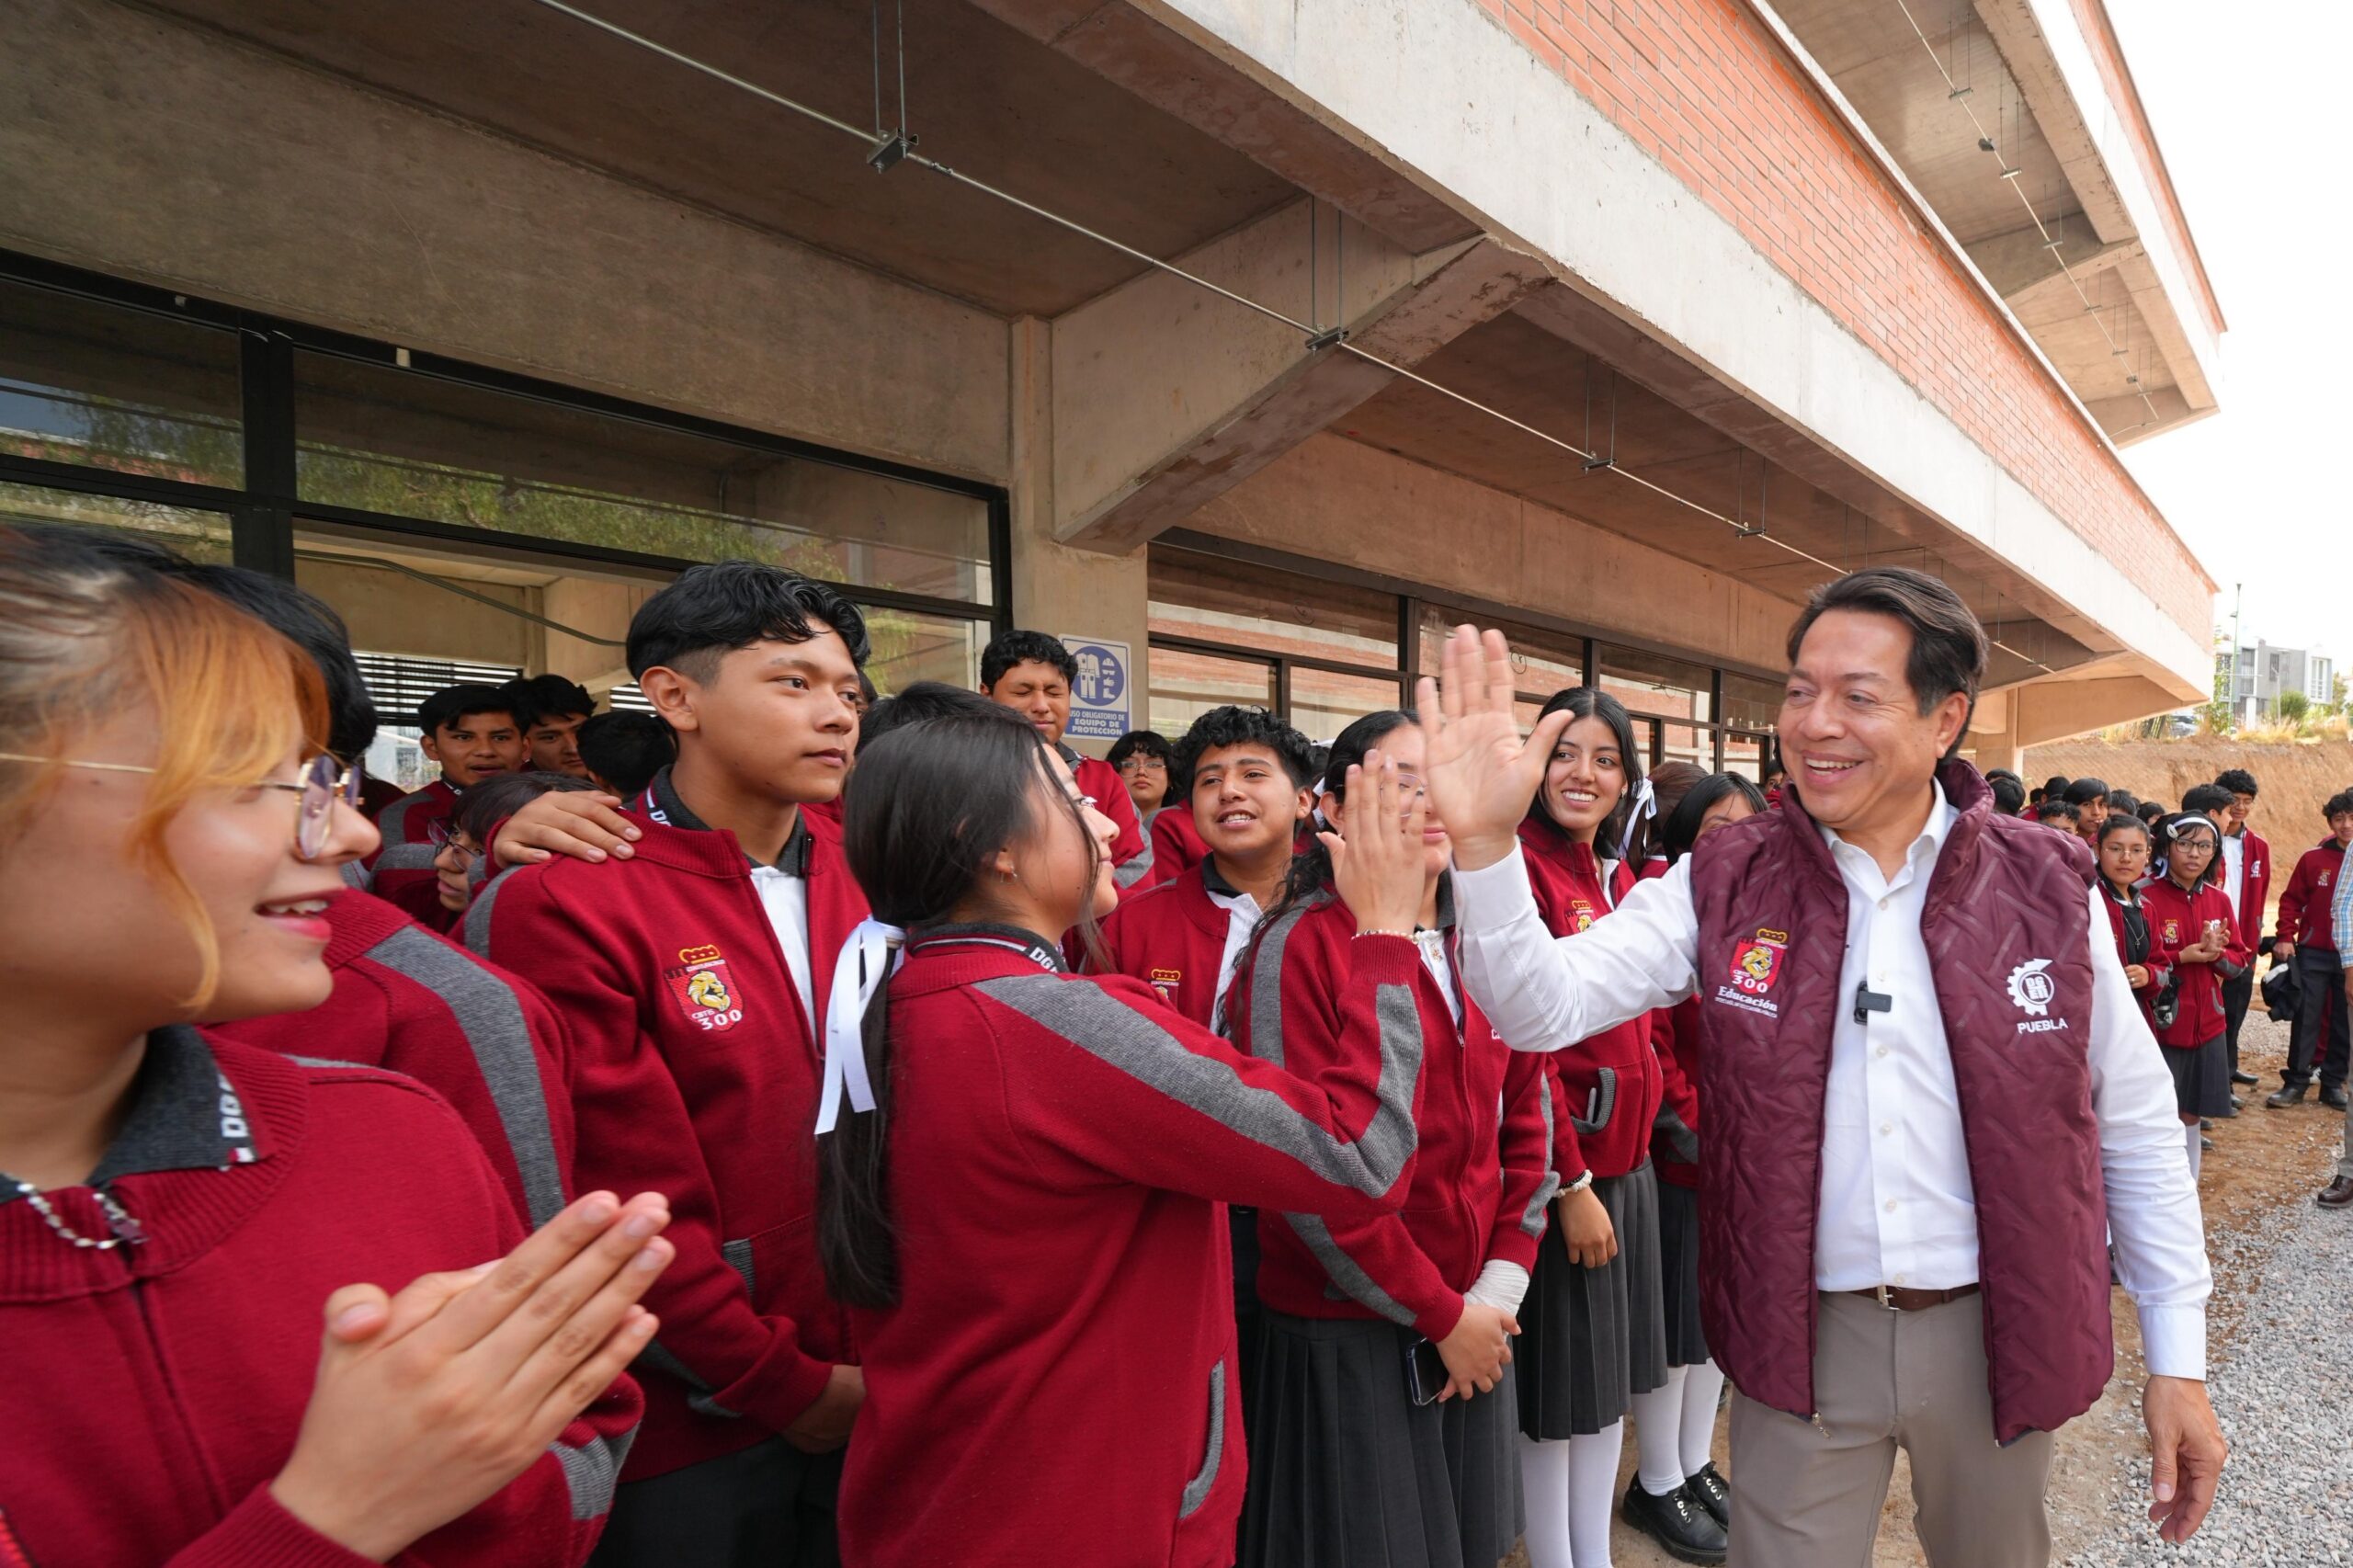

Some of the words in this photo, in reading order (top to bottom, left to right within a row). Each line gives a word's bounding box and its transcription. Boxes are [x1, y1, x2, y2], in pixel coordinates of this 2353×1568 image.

[1082, 710, 1117, 721] OBLIGATORIO
[1072, 726, 1122, 735] PROTECCION
[1732, 974, 1768, 993] 300
[1718, 985, 1778, 1012] Educación
[698, 1009, 743, 1030] 300
[2017, 1017, 2069, 1034] PUEBLA
